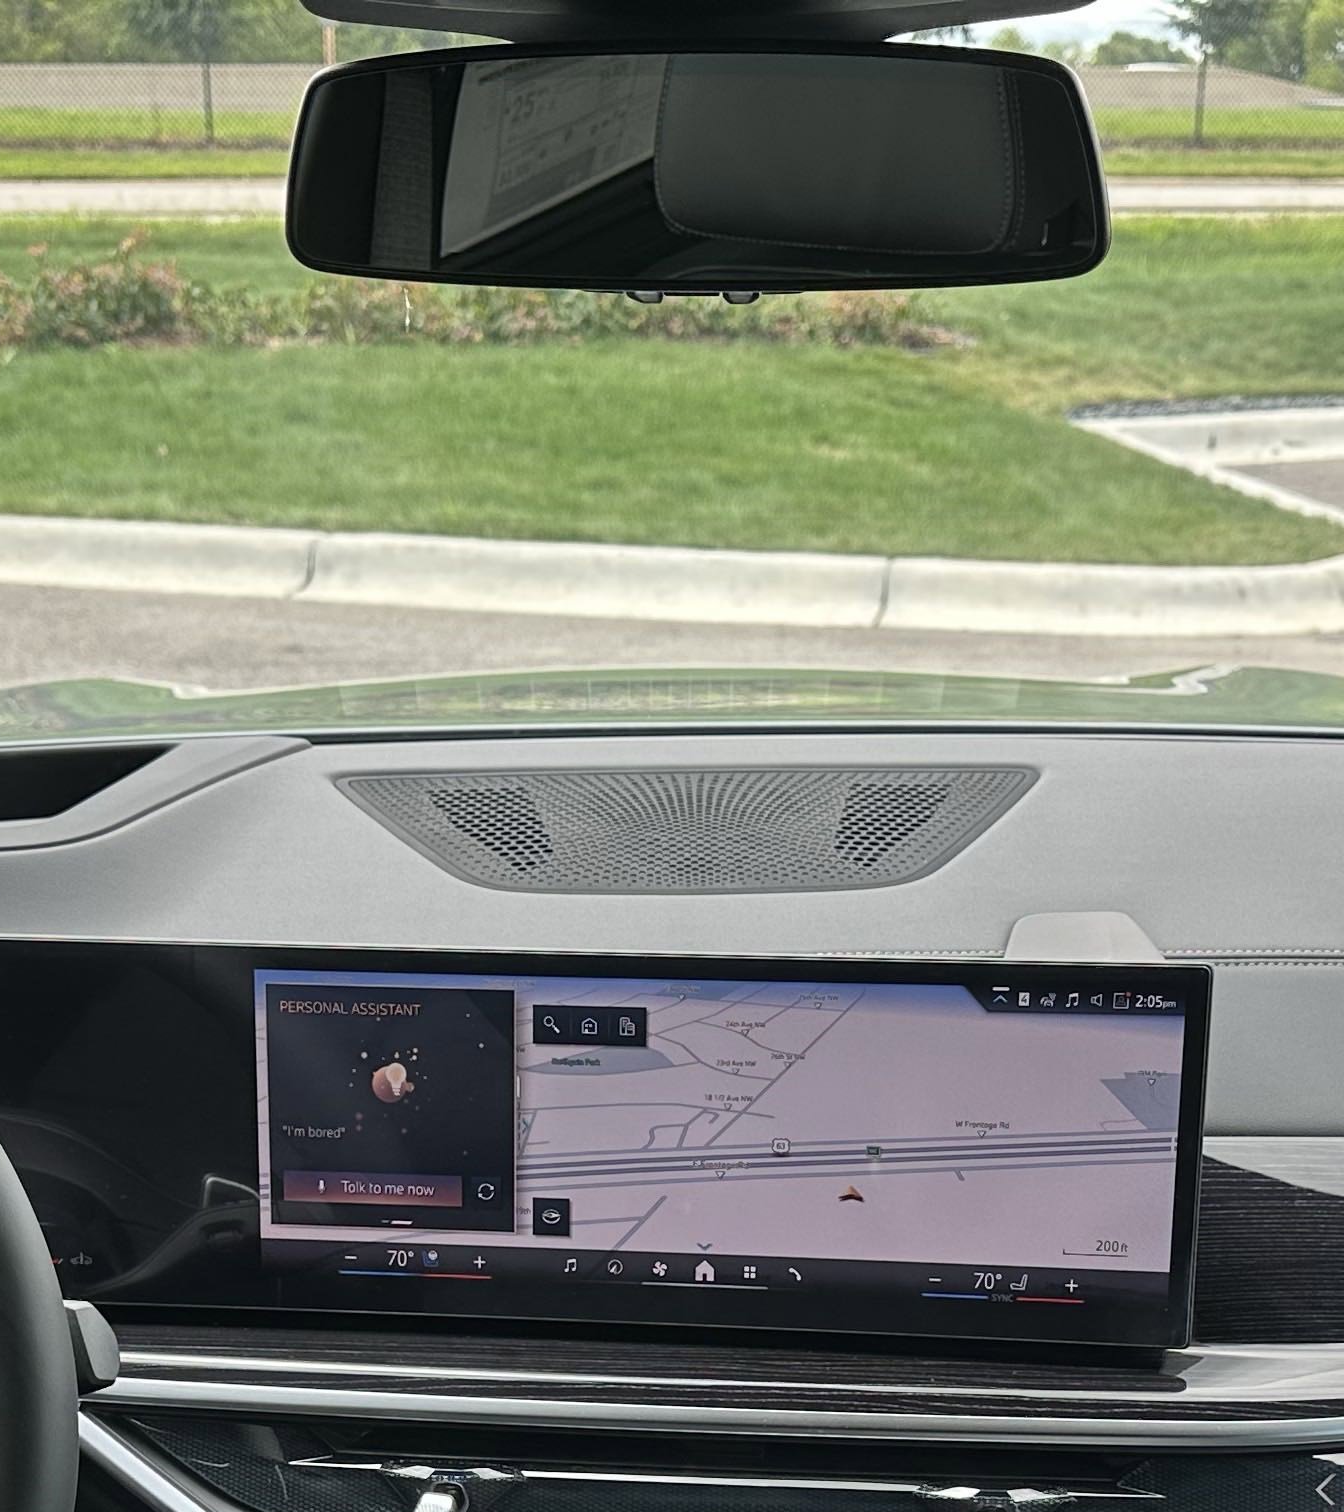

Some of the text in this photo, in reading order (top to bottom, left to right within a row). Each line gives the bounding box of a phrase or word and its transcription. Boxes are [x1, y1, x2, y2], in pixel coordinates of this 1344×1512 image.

[279, 1000, 421, 1016] PERSONAL ASSISTANT
[964, 1120, 997, 1130] Frontage
[341, 1181, 435, 1197] Talk to me now
